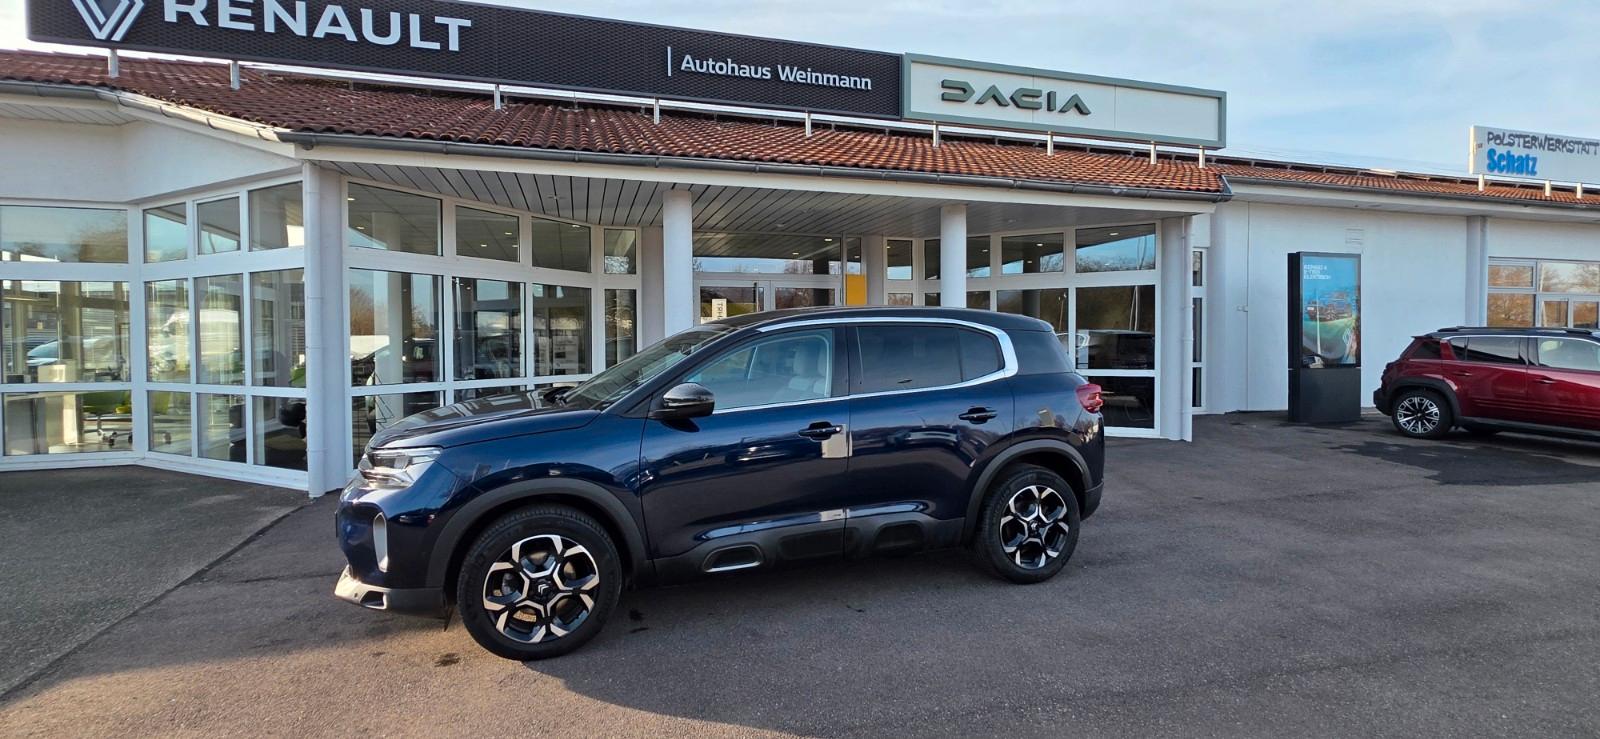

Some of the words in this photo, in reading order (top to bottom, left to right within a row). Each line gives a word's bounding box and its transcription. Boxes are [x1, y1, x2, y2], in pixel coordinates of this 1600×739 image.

[164, 0, 472, 51] RENAULT
[681, 54, 772, 79] Autohaus
[777, 64, 872, 90] Weinmann
[941, 79, 1092, 115] DACIA
[1487, 131, 1600, 156] POLSTERWERKSTATT
[1487, 148, 1538, 176] Schatz
